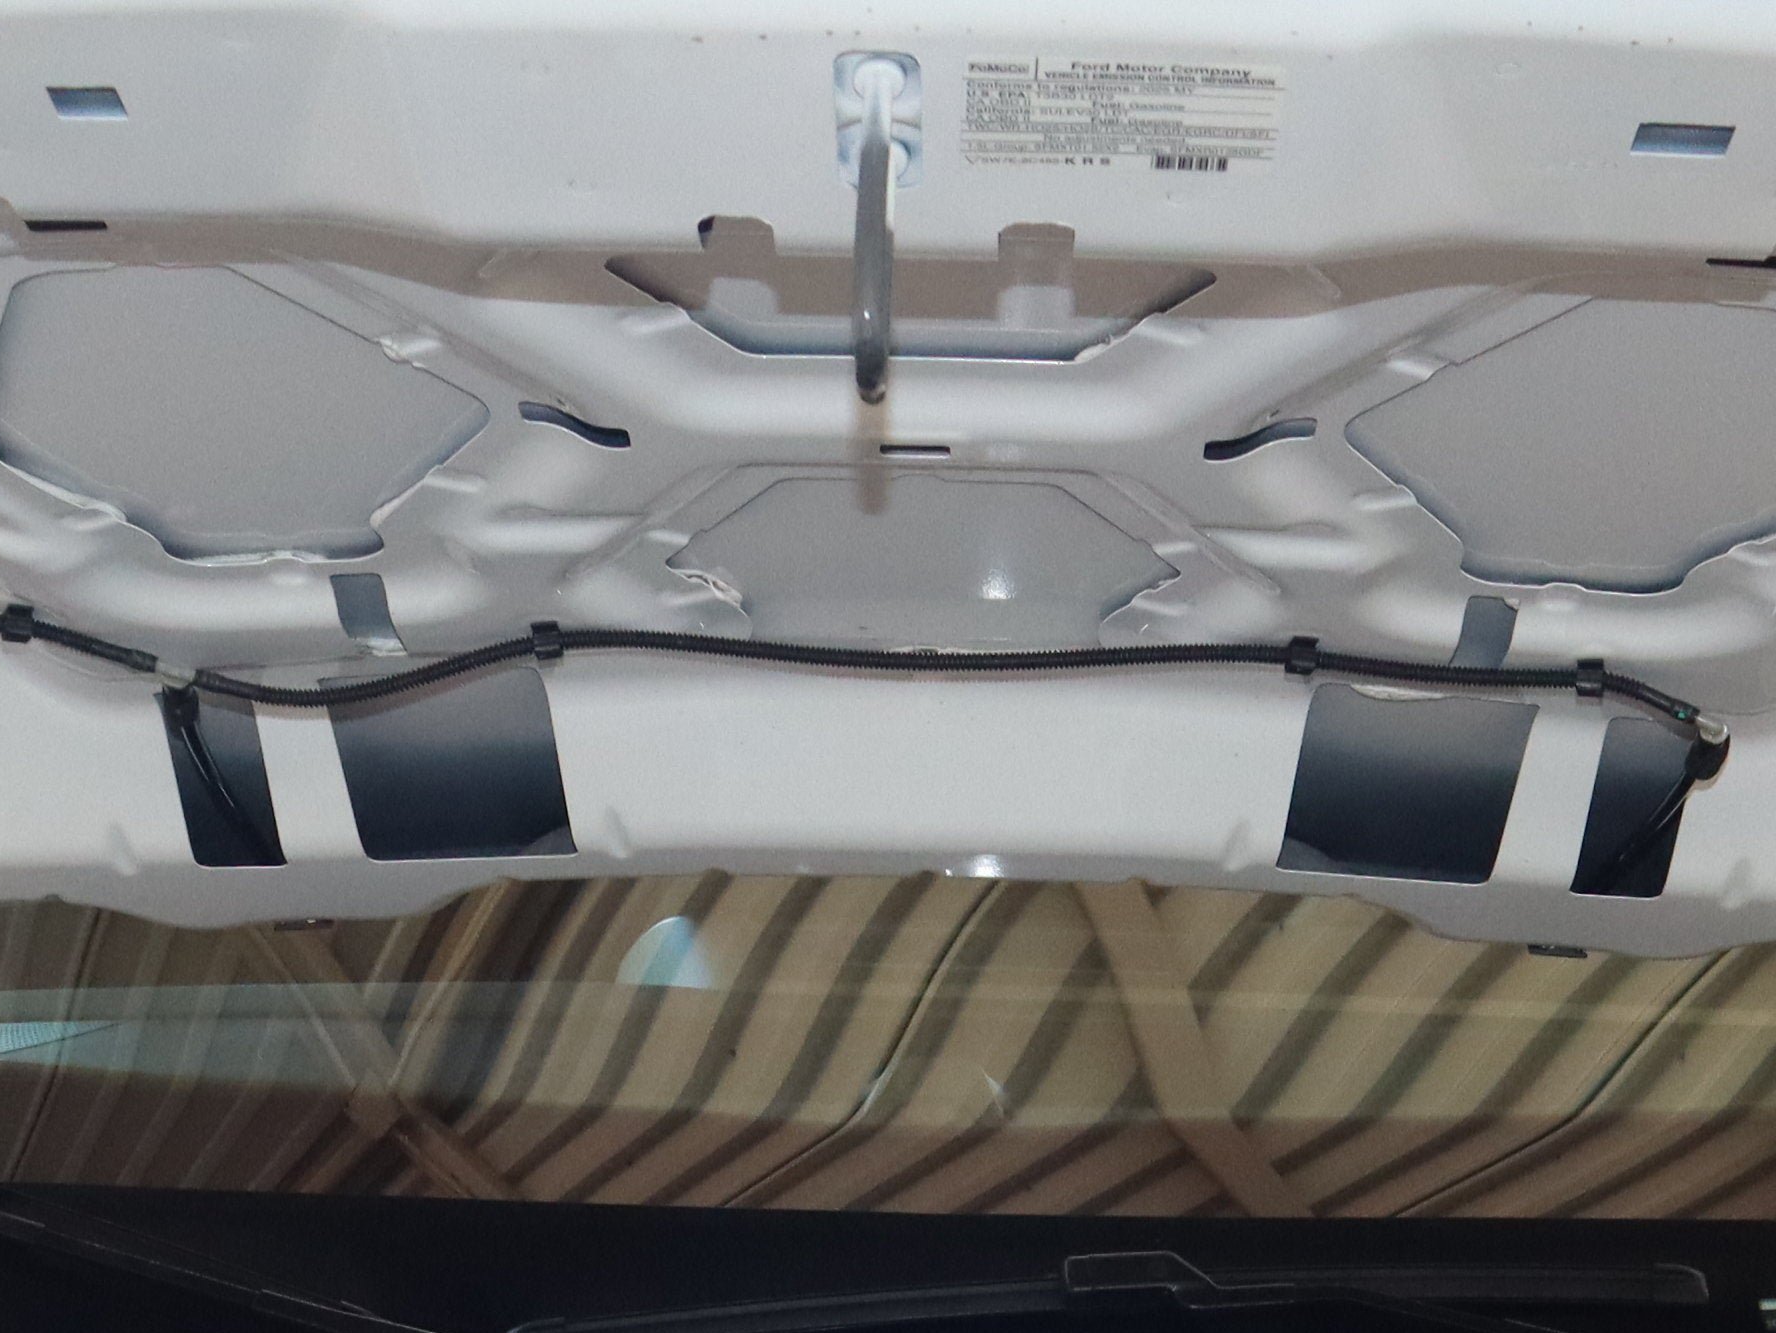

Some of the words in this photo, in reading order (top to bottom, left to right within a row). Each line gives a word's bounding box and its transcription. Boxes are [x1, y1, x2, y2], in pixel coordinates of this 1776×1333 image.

[1071, 62, 1110, 72] Ford
[1116, 63, 1164, 73] Motor
[1171, 65, 1252, 77] Company
